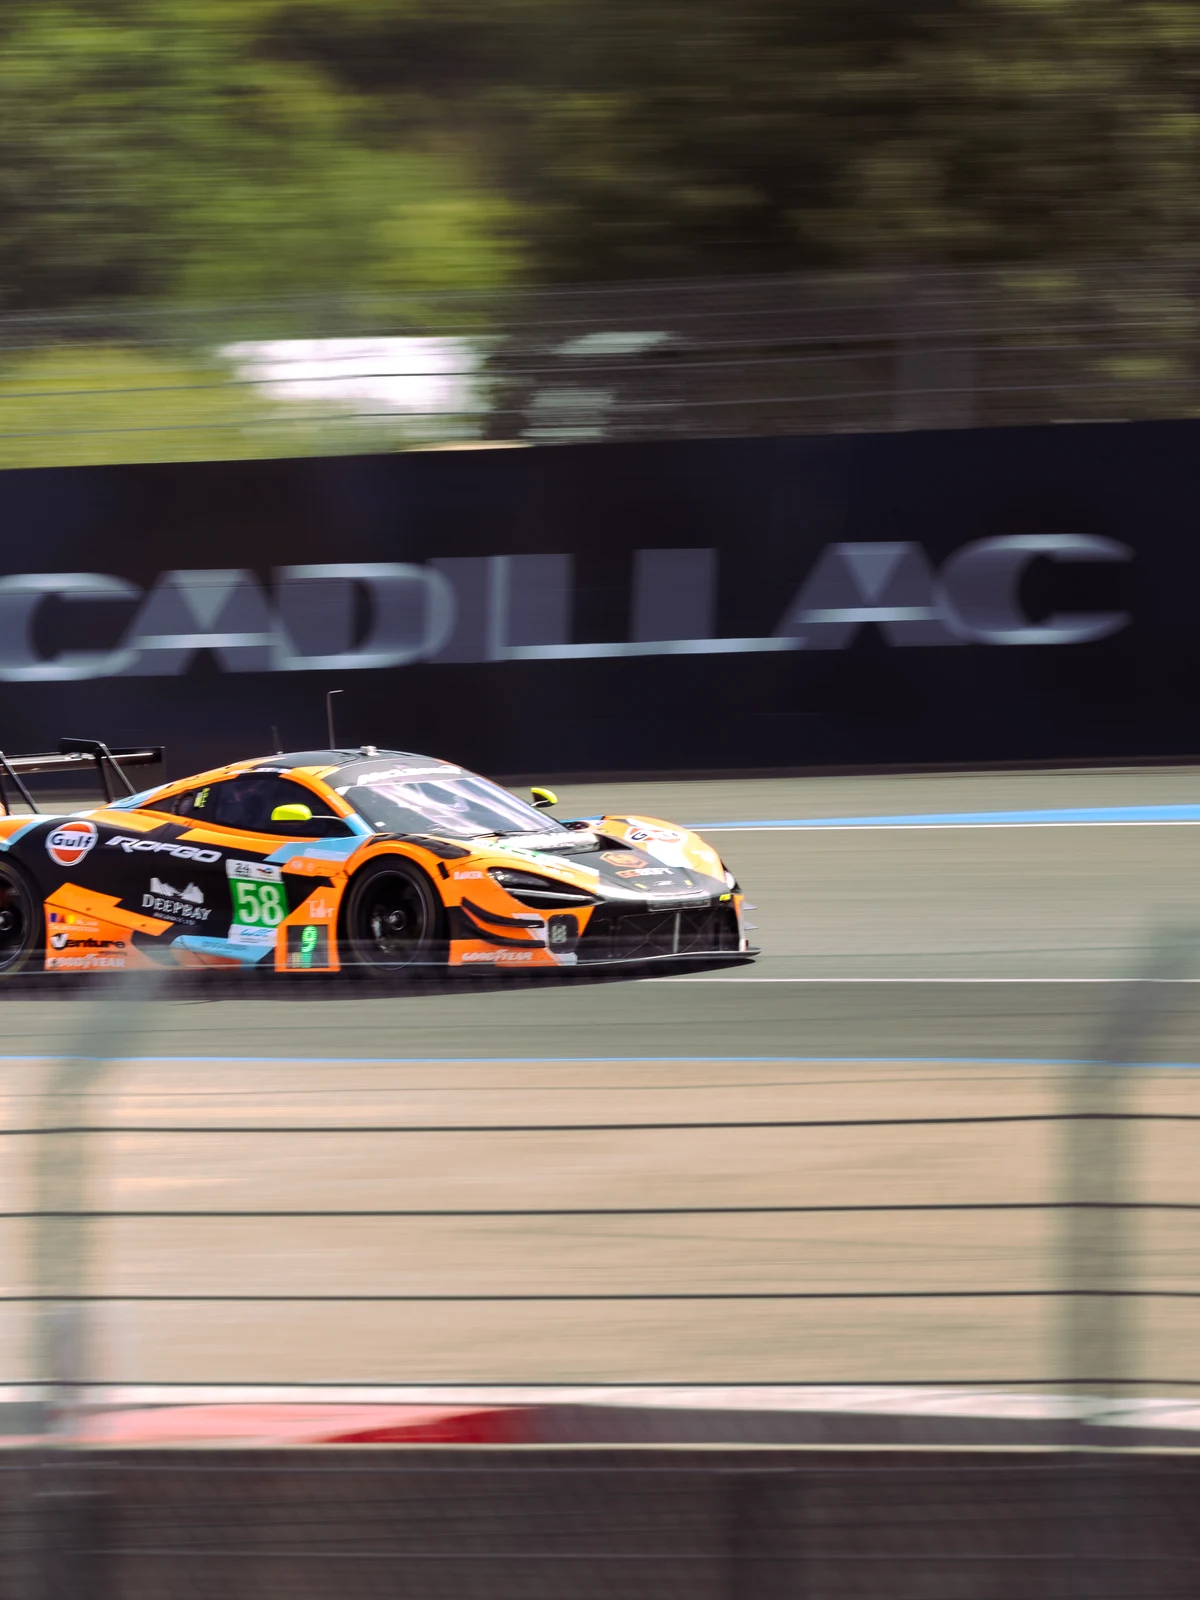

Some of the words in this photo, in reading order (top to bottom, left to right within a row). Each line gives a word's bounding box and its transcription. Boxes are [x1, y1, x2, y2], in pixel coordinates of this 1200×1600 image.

[51, 833, 94, 848] Gulf
[105, 835, 222, 863] ROFGO
[142, 893, 212, 921] DEEPBAY
[236, 881, 285, 926] 58
[50, 933, 126, 950] Venture
[301, 925, 318, 953] 9
